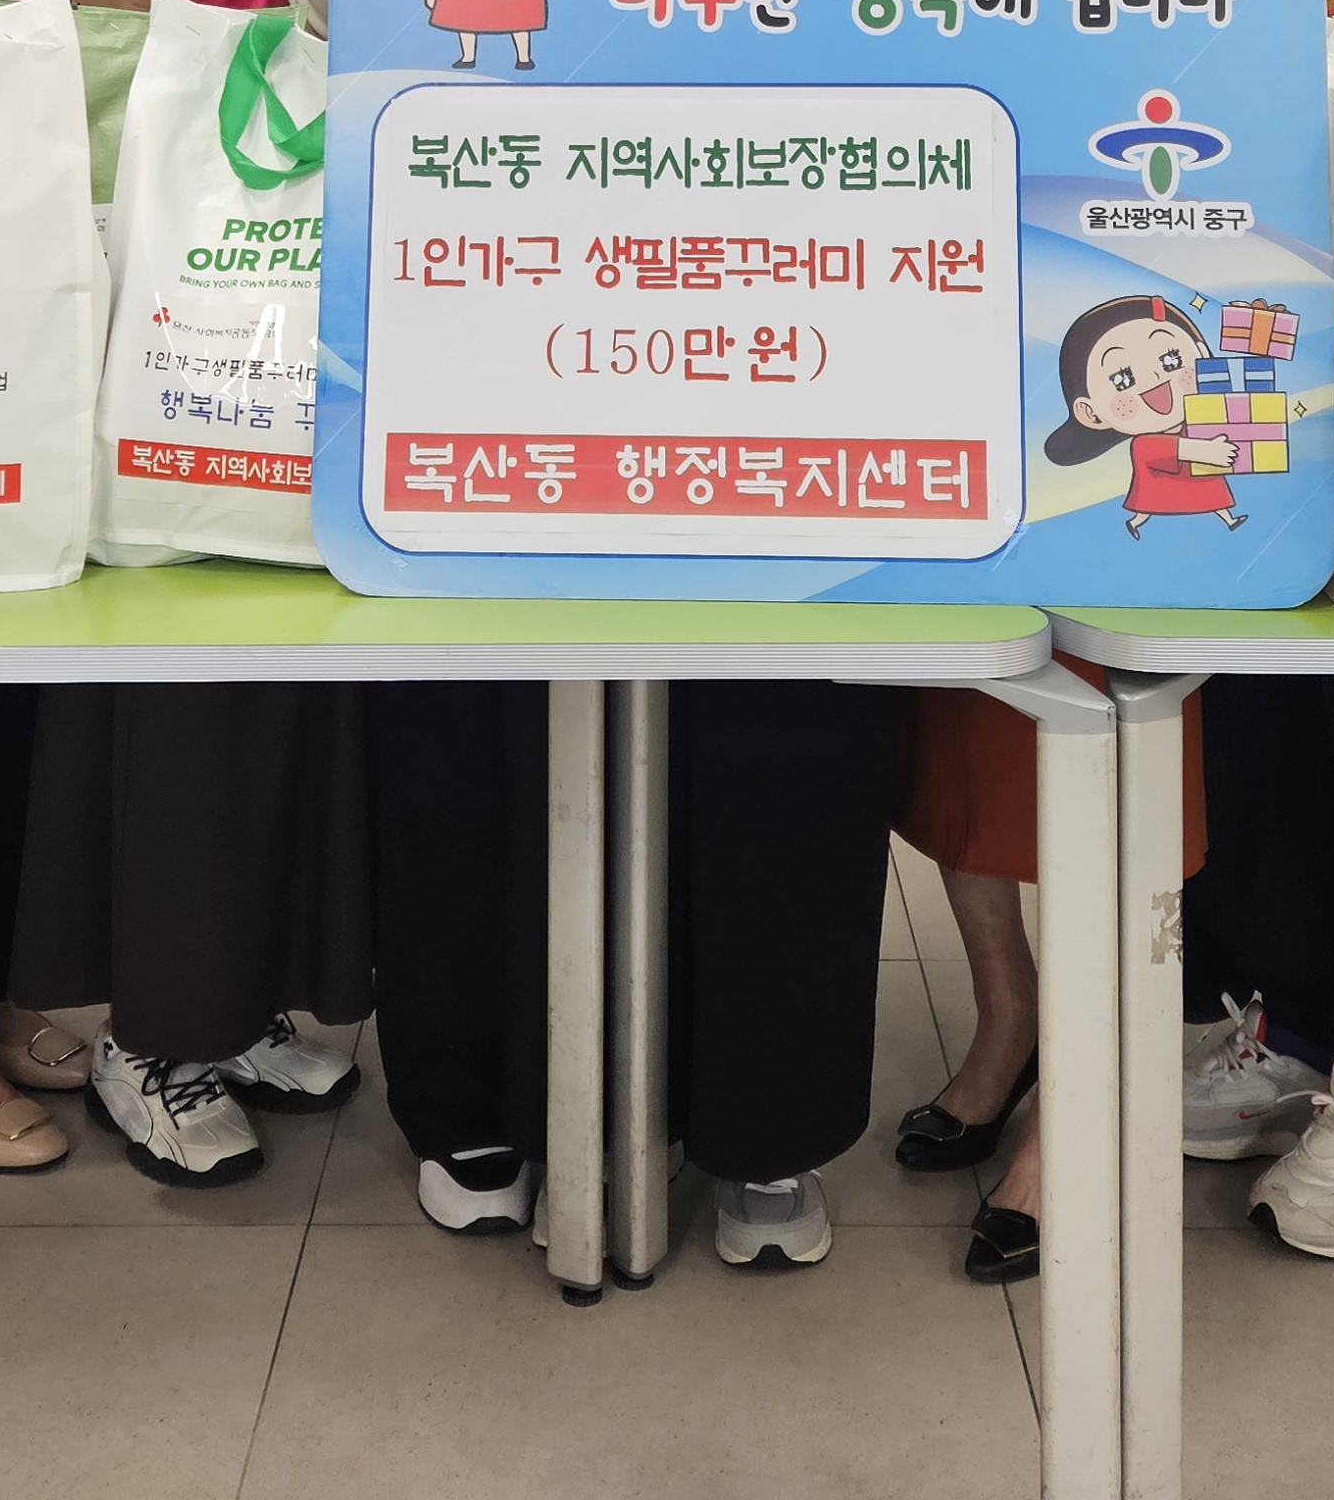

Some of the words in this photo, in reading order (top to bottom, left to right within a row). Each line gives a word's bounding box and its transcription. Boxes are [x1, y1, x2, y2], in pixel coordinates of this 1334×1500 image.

[408, 132, 543, 190] 복산동
[565, 136, 973, 192] 지역사회보장협의체
[222, 218, 323, 243] PROTE
[1085, 205, 1196, 233] 울산광역시
[1200, 205, 1249, 232] 중구
[187, 248, 261, 272] OUR
[267, 248, 321, 272] PLA
[392, 236, 561, 288] 1인가구
[585, 236, 866, 292] 생필품꾸러미
[890, 239, 985, 293] 지원
[179, 275, 210, 288] BRING
[213, 280, 238, 289] YOUR
[240, 279, 265, 288] OWN
[268, 279, 288, 288] BAG
[290, 280, 311, 289] AND
[161, 389, 274, 430] 행복나눔
[132, 445, 196, 476] 복산동
[205, 455, 312, 486] 지역사회보
[403, 442, 578, 506] 복산동
[615, 445, 973, 510] 행정복지센터
